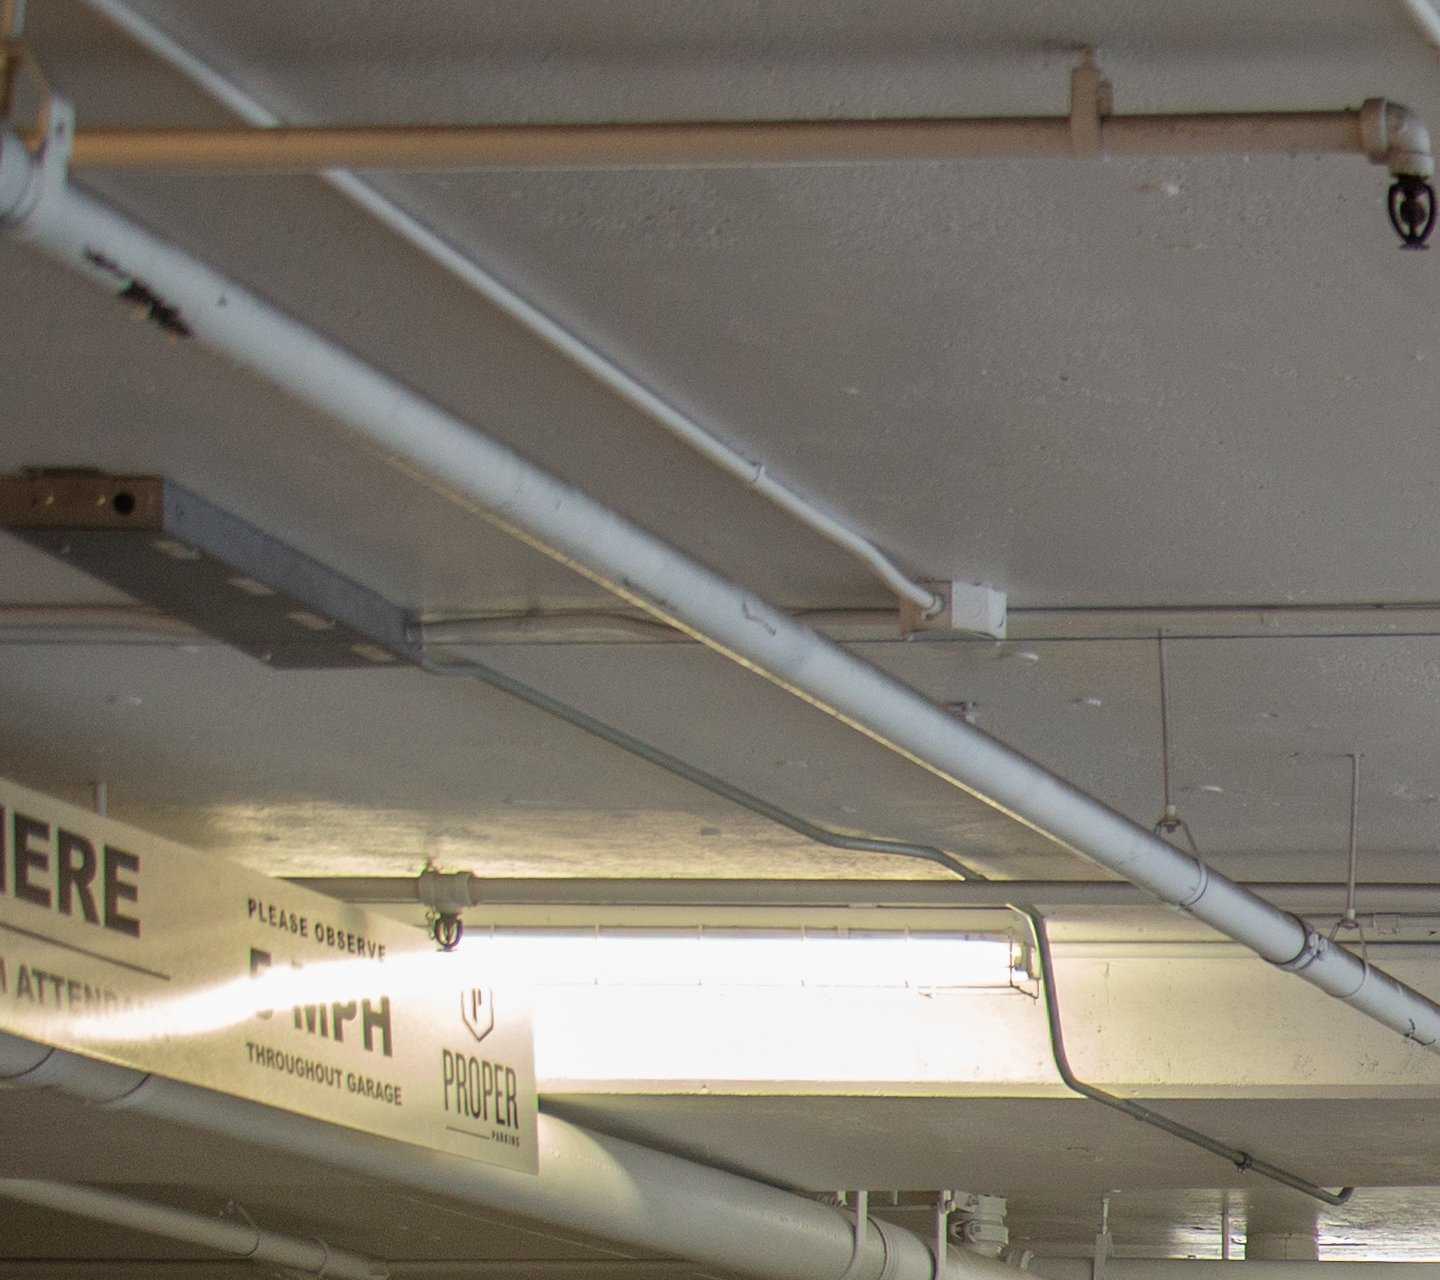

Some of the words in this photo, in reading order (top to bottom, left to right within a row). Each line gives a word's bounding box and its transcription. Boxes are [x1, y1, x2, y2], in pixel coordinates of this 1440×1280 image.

[0, 804, 141, 938] ERE
[248, 898, 309, 938] PLEASE
[246, 1042, 342, 1089] THROUGHOUT
[347, 1072, 403, 1106] GARAGE
[442, 1048, 519, 1130] PROPER
